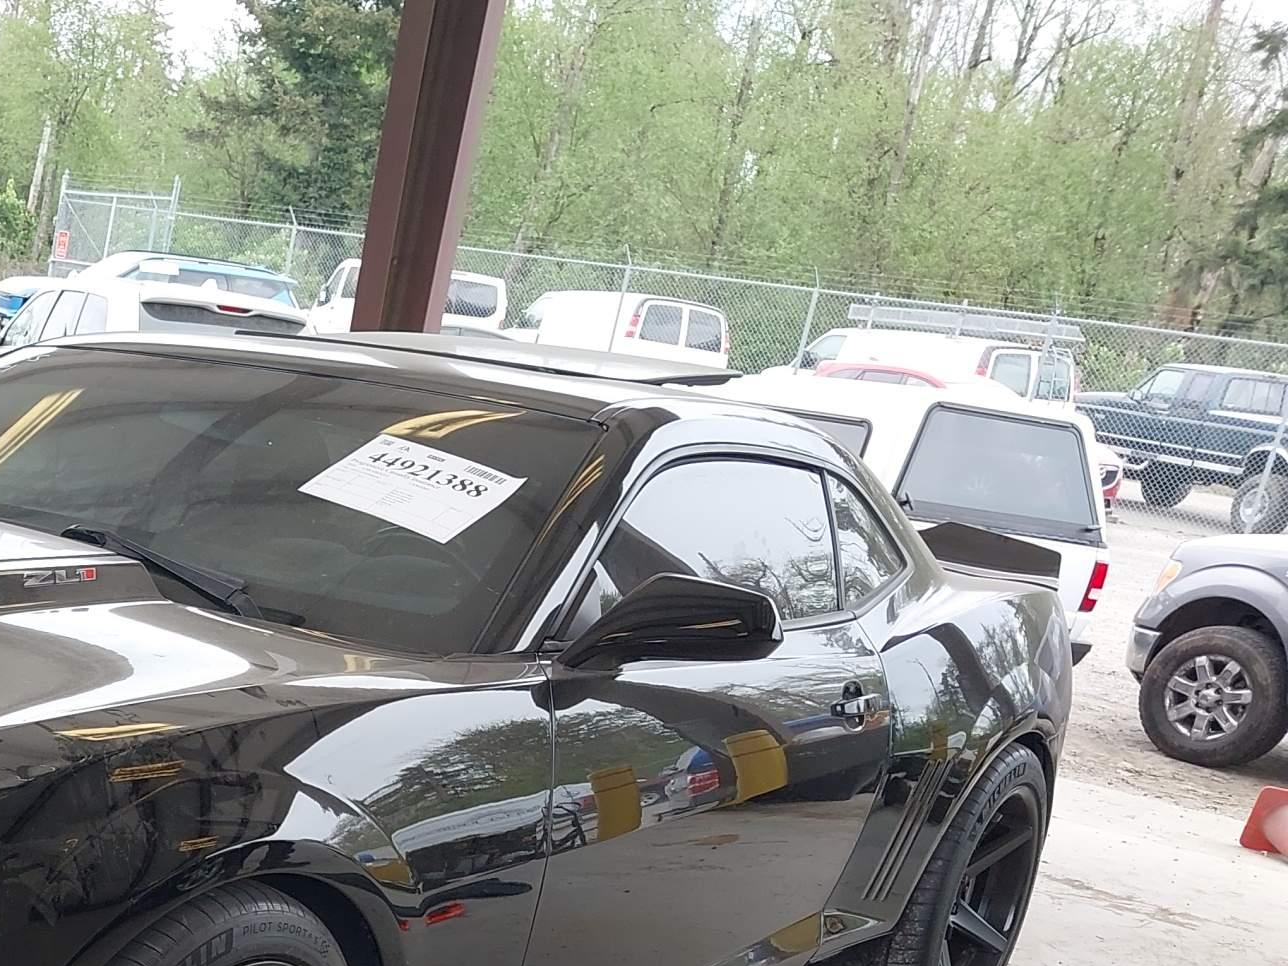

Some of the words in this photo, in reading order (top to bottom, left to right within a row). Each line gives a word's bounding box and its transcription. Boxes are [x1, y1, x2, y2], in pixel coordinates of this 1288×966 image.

[368, 452, 489, 498] 44921388
[23, 567, 97, 588] ZL1
[242, 921, 273, 937] PILOT
[276, 922, 309, 938] SPORT
